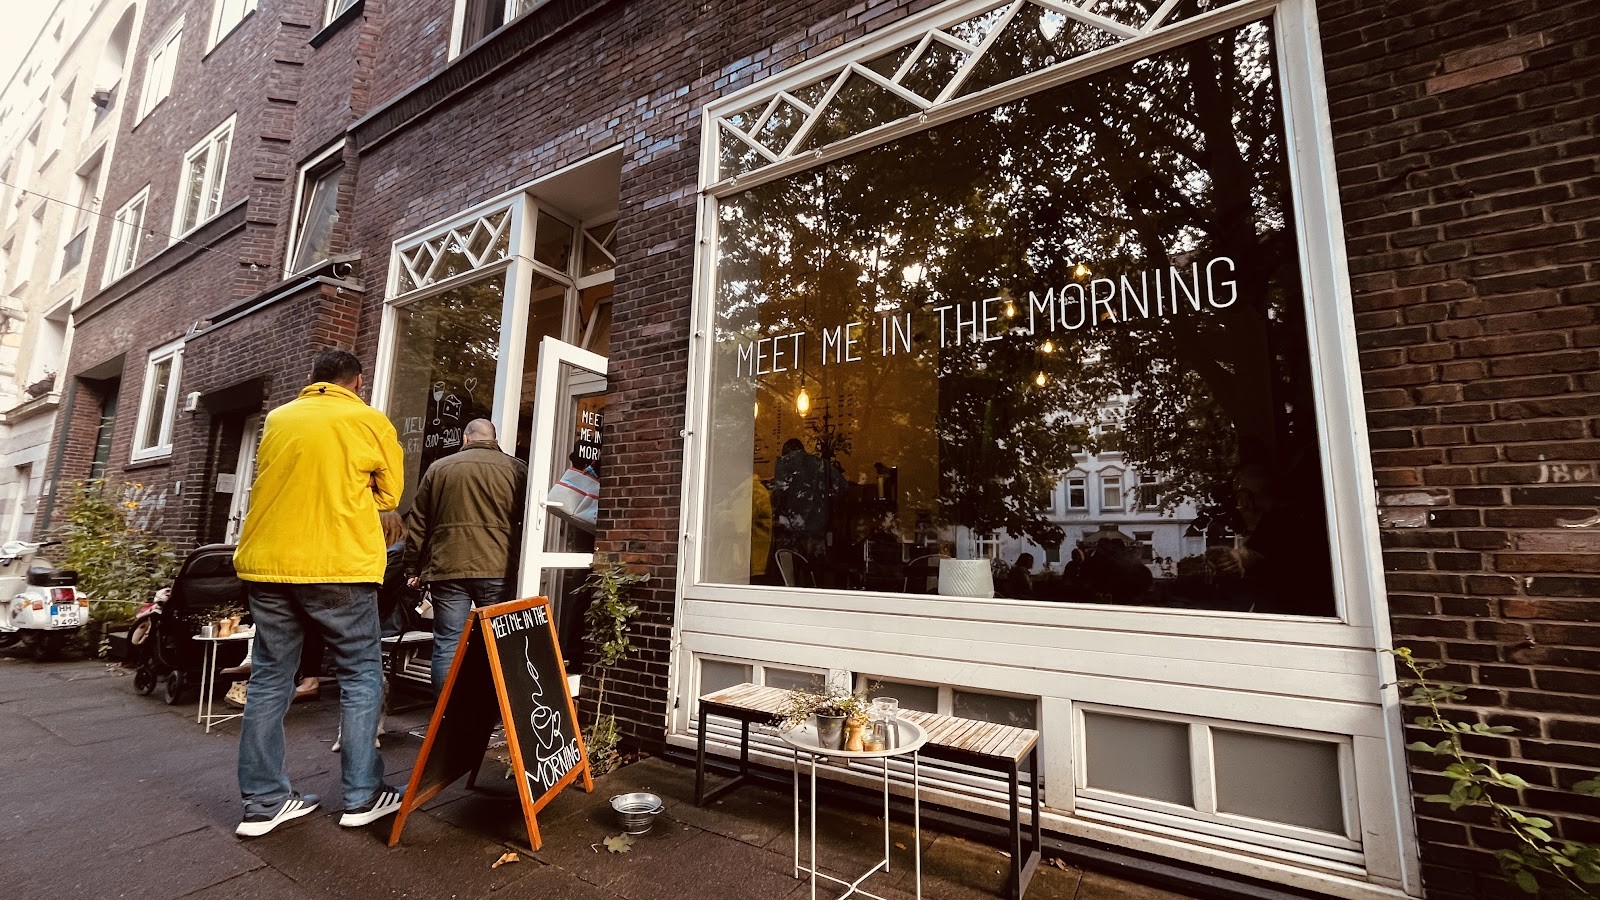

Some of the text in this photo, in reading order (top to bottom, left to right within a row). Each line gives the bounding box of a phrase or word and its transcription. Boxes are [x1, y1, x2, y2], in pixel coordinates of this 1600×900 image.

[736, 256, 1240, 378] MEET ME IN THE MORNING
[580, 428, 592, 443] ME
[491, 605, 548, 639] MEET ME IN THE
[525, 738, 580, 804] MORNING
